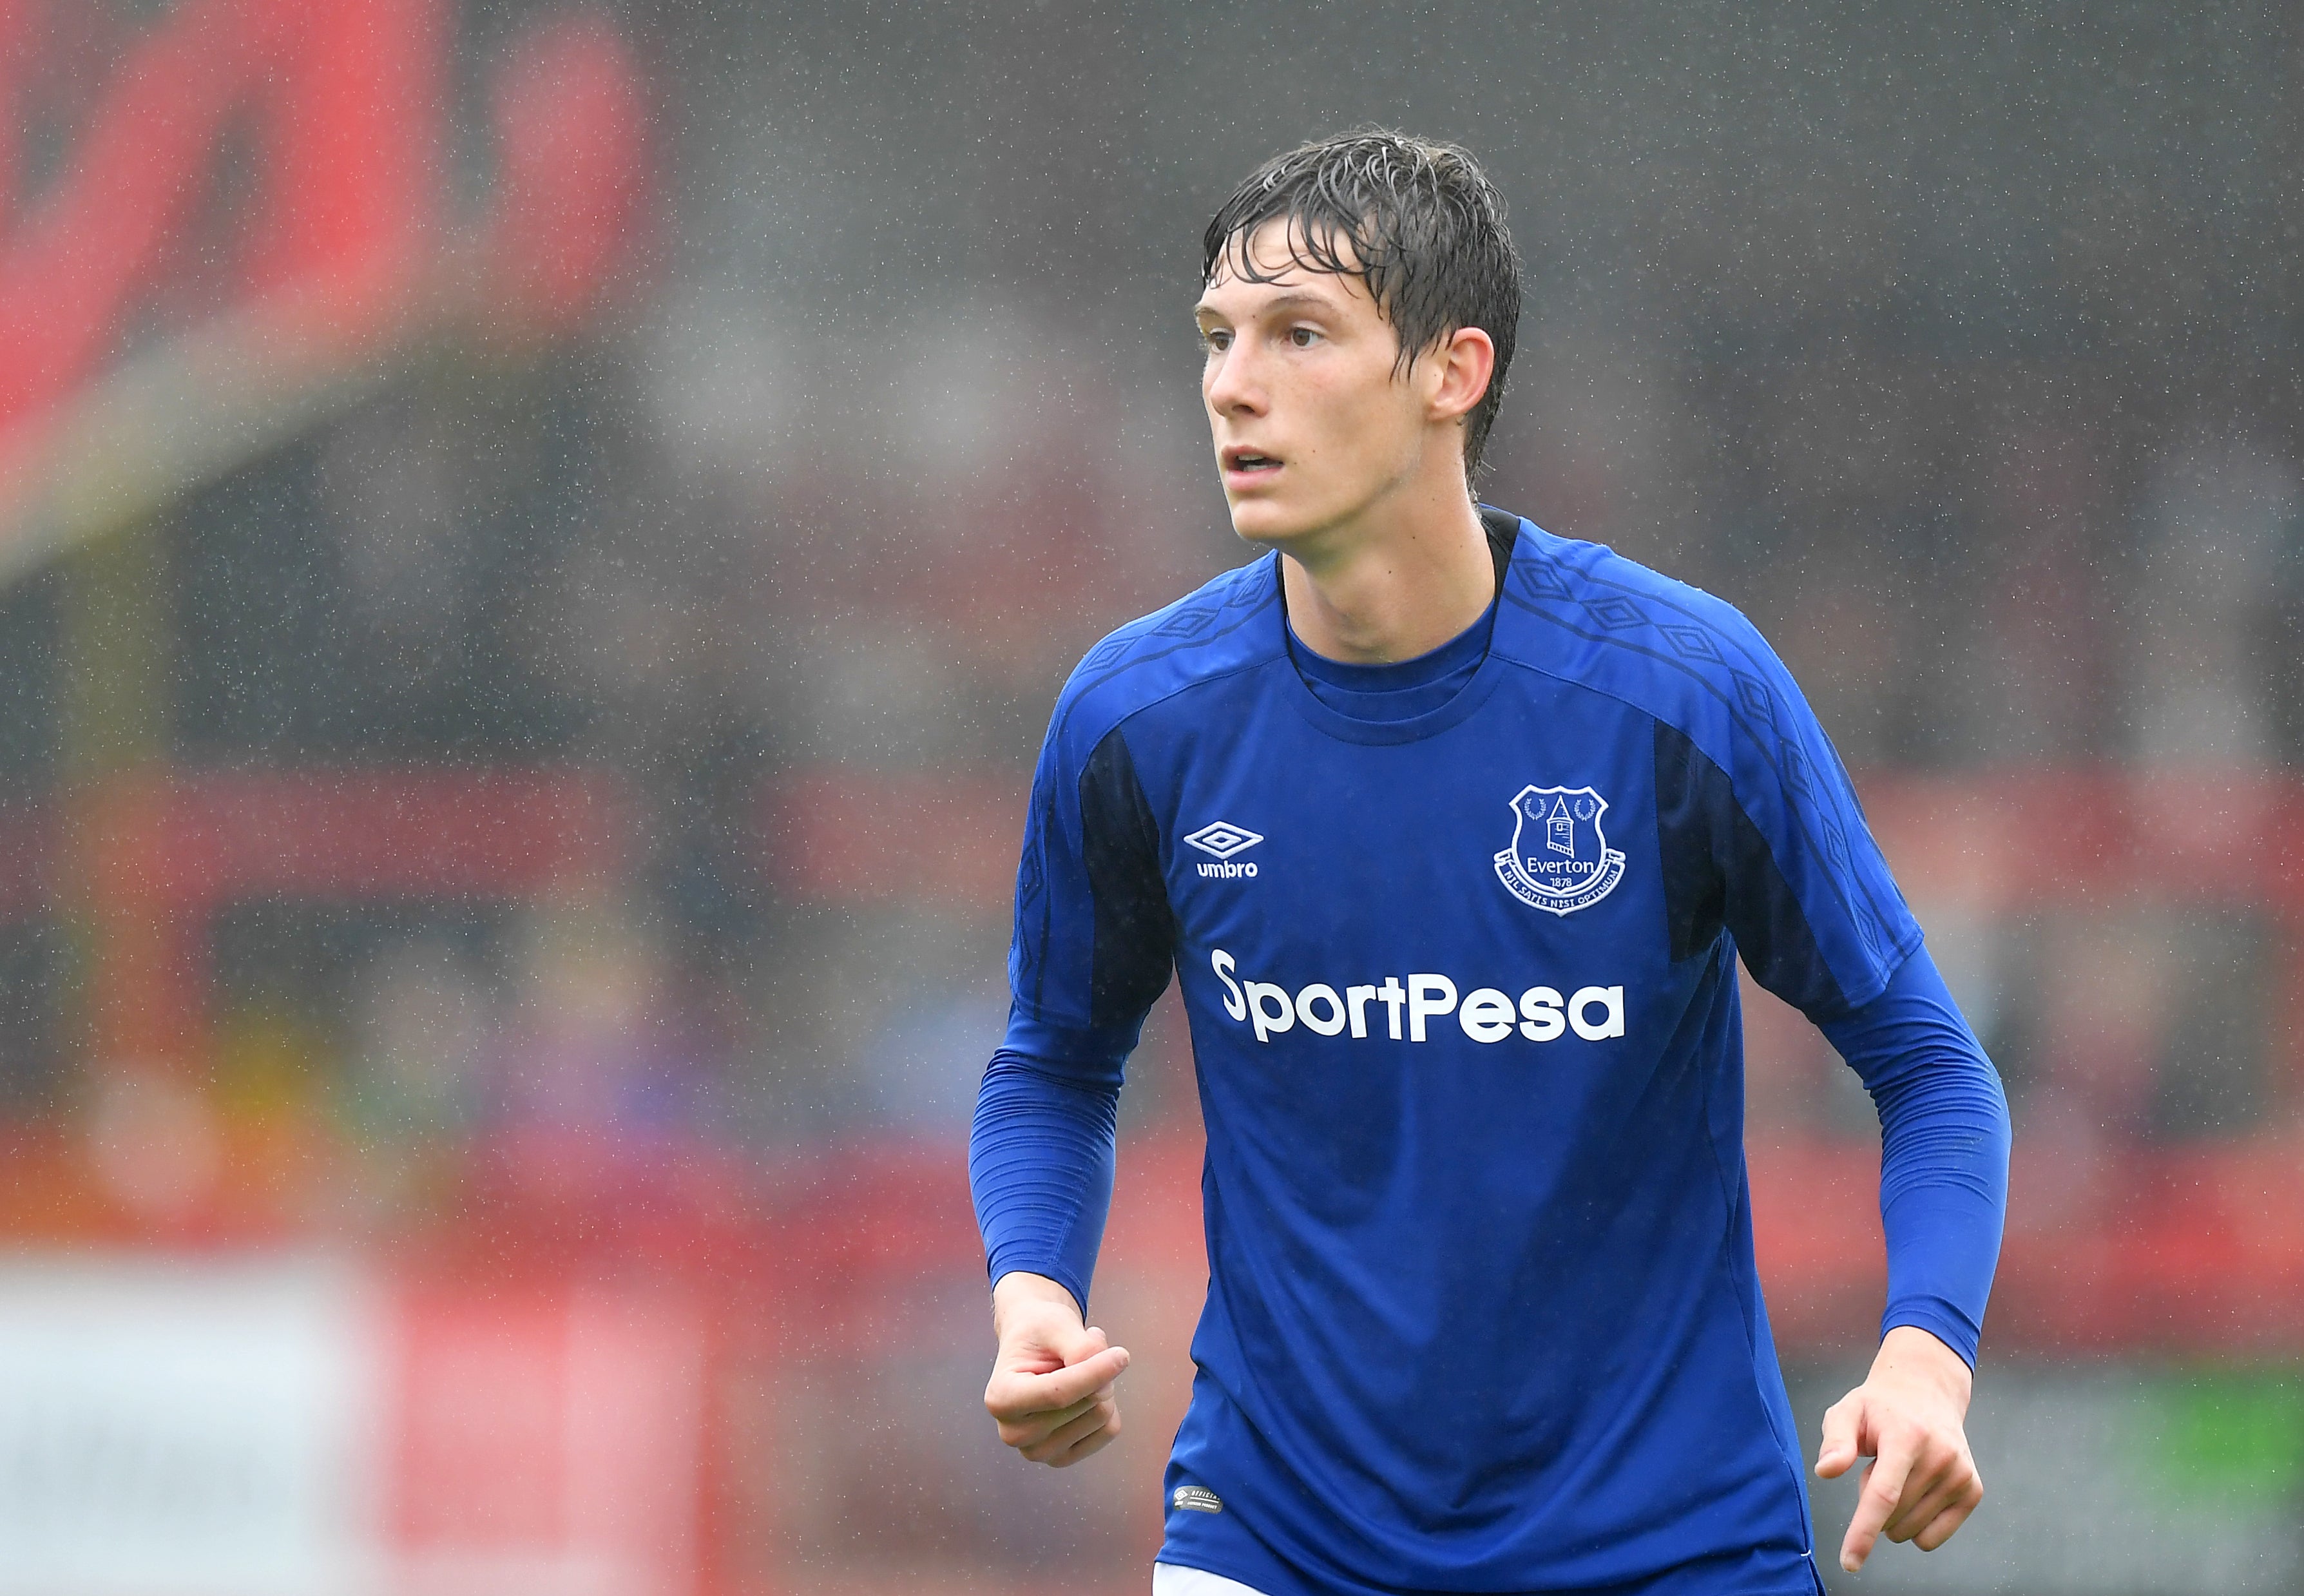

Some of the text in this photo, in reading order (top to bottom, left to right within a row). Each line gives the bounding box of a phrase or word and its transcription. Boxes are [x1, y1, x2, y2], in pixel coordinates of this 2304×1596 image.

[1196, 860, 1258, 879] umbro
[1527, 857, 1595, 874] Everton
[1504, 870, 1618, 908] NIL SATIS NISI OPTIMUM
[1550, 877, 1572, 888] 1878
[1211, 948, 1625, 1043] SportPesa
